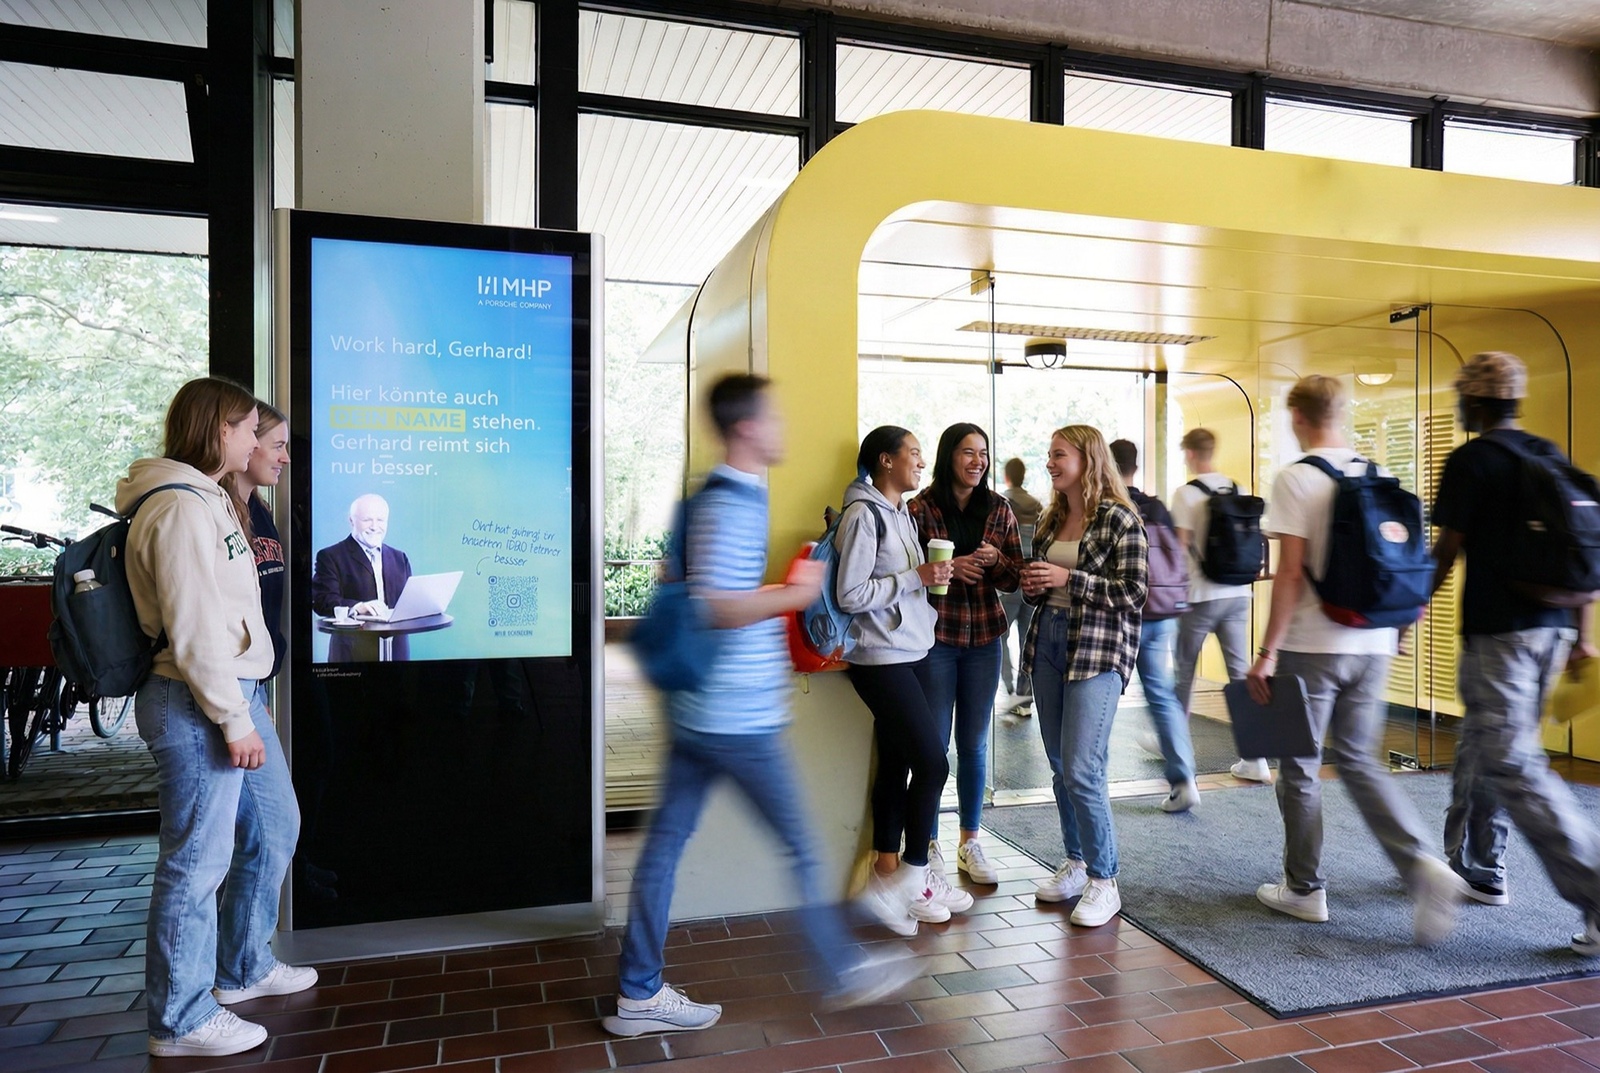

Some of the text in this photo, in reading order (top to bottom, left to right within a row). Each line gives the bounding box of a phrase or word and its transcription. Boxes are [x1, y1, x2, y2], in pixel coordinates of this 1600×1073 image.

[502, 277, 552, 298] MHP
[485, 300, 518, 308] PORSCHE
[519, 301, 552, 310] COMPANY
[330, 335, 532, 360] Work hard, Gerhard!
[331, 384, 499, 406] Hier könnte auch
[334, 409, 541, 430] DEIN NAME stehen.
[330, 434, 510, 453] Gerhard reimt sich
[331, 458, 438, 476] nur besser.
